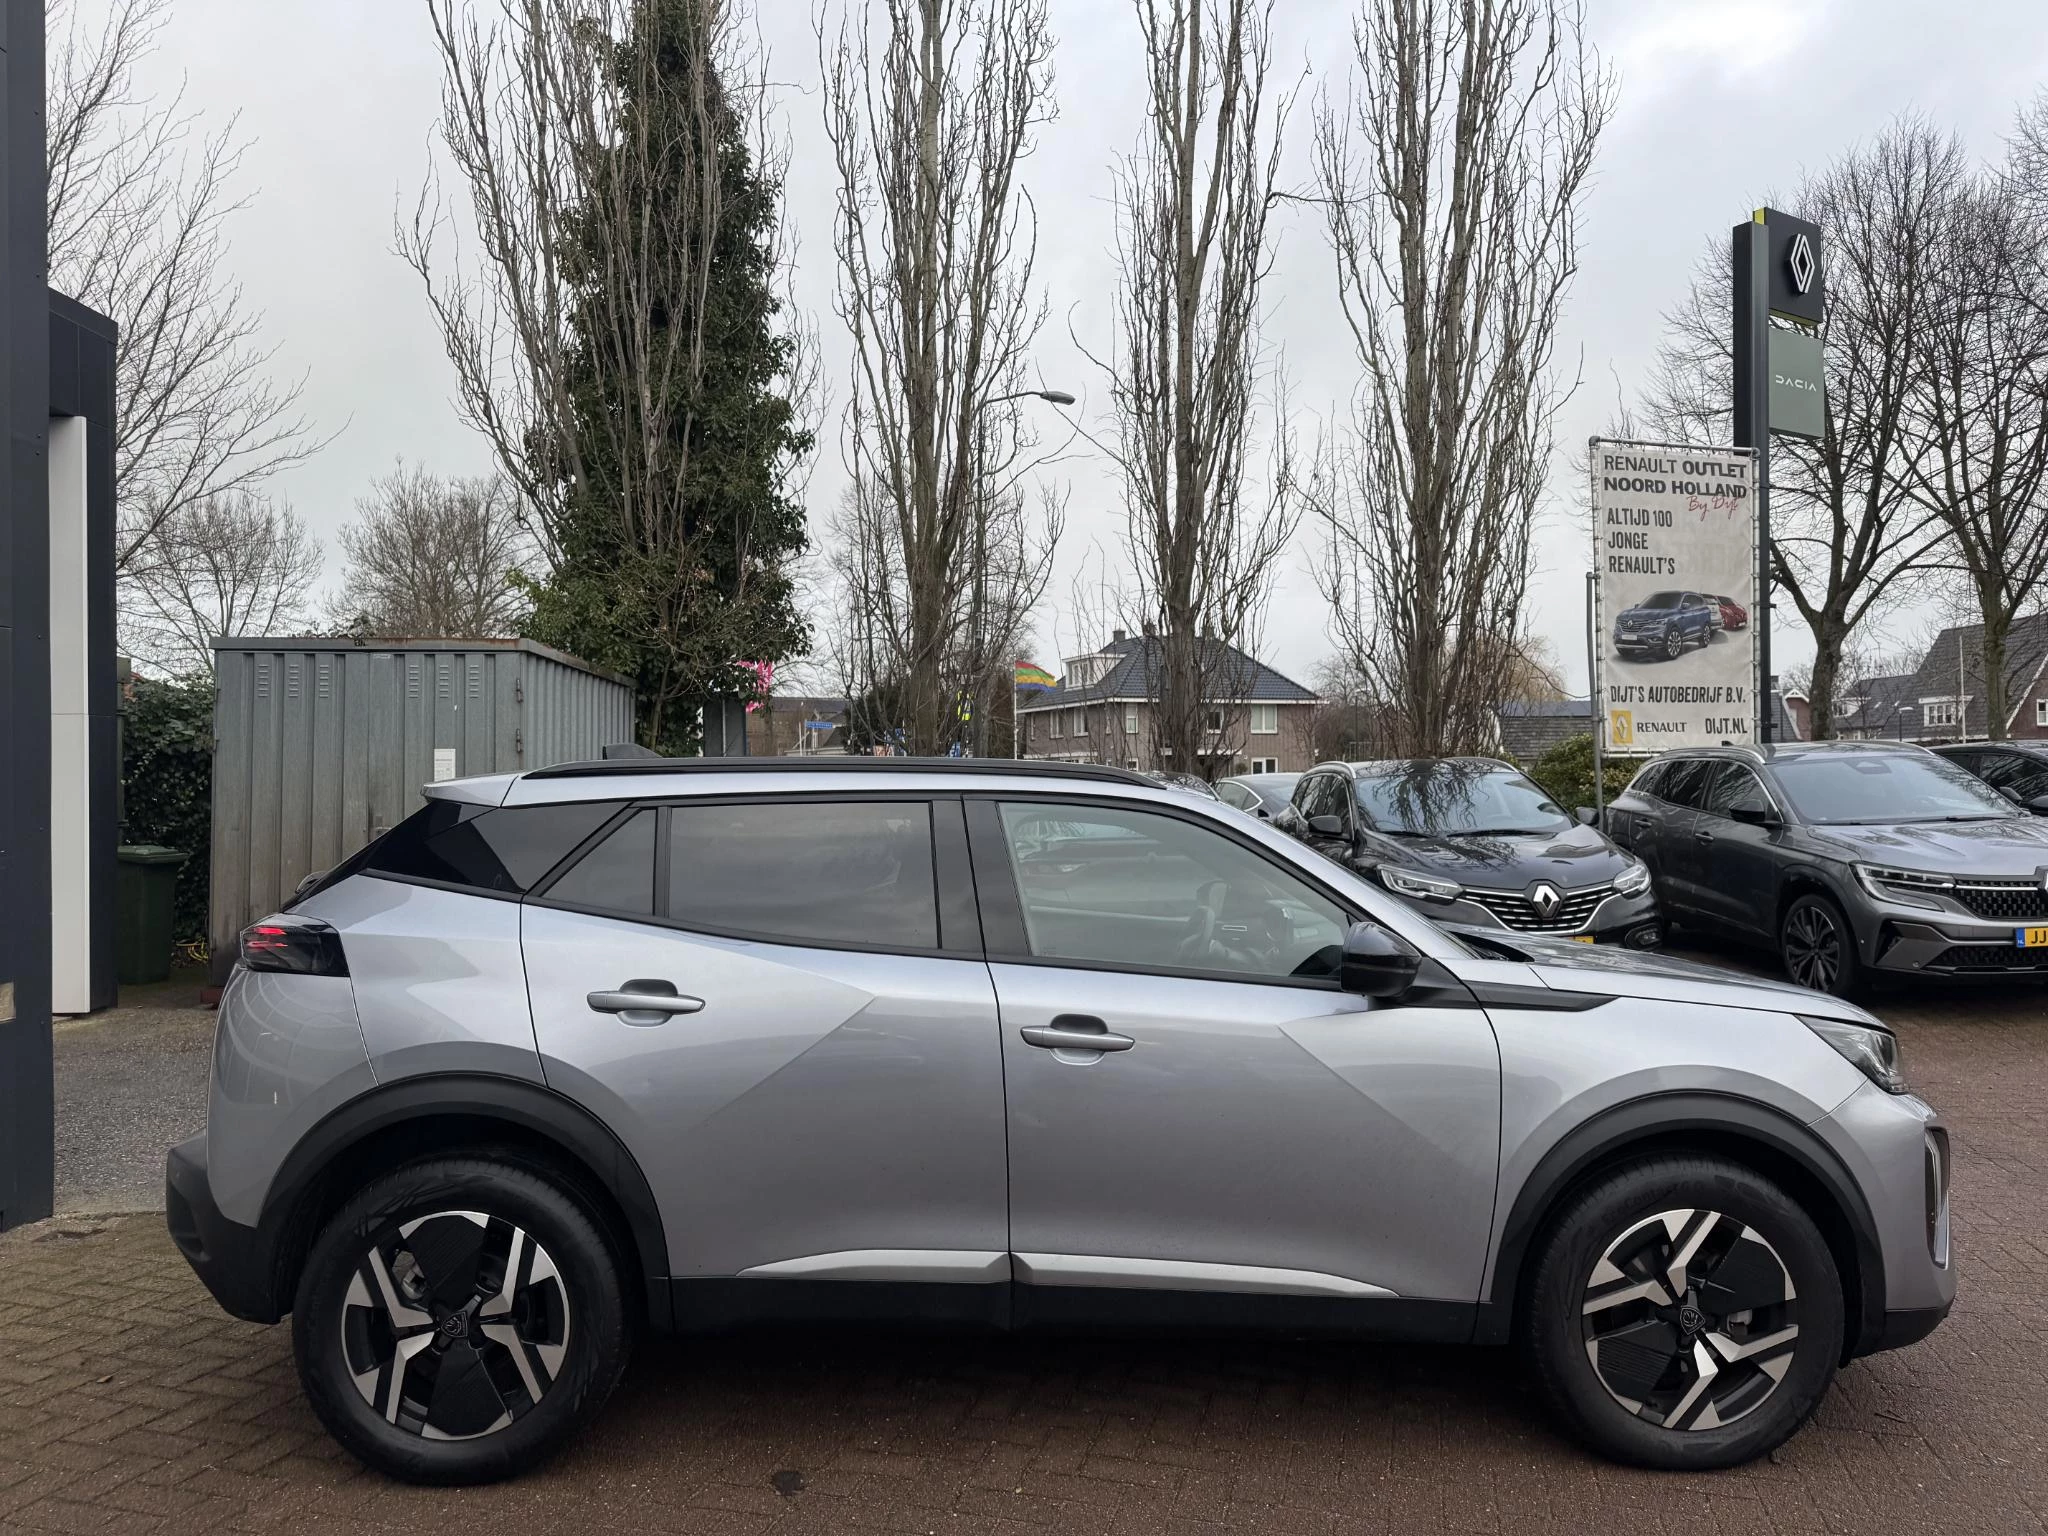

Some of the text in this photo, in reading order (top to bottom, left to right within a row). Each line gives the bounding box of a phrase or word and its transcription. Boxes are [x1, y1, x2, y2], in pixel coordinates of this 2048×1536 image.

[1775, 374, 1817, 392] DACIA
[1604, 455, 1747, 479] RENAULT OUTLET
[1604, 477, 1747, 499] NOORD HOLLAND
[1607, 508, 1673, 527] ALTIJD 100
[1686, 495, 1710, 521] By
[1608, 531, 1649, 550] JONGE
[1608, 555, 1676, 574] RENAULT'S
[1610, 686, 1746, 703] DIJT'S AUTOBEDRIJF B.V.
[1636, 717, 1748, 734] RENAULT DIJT.NL
